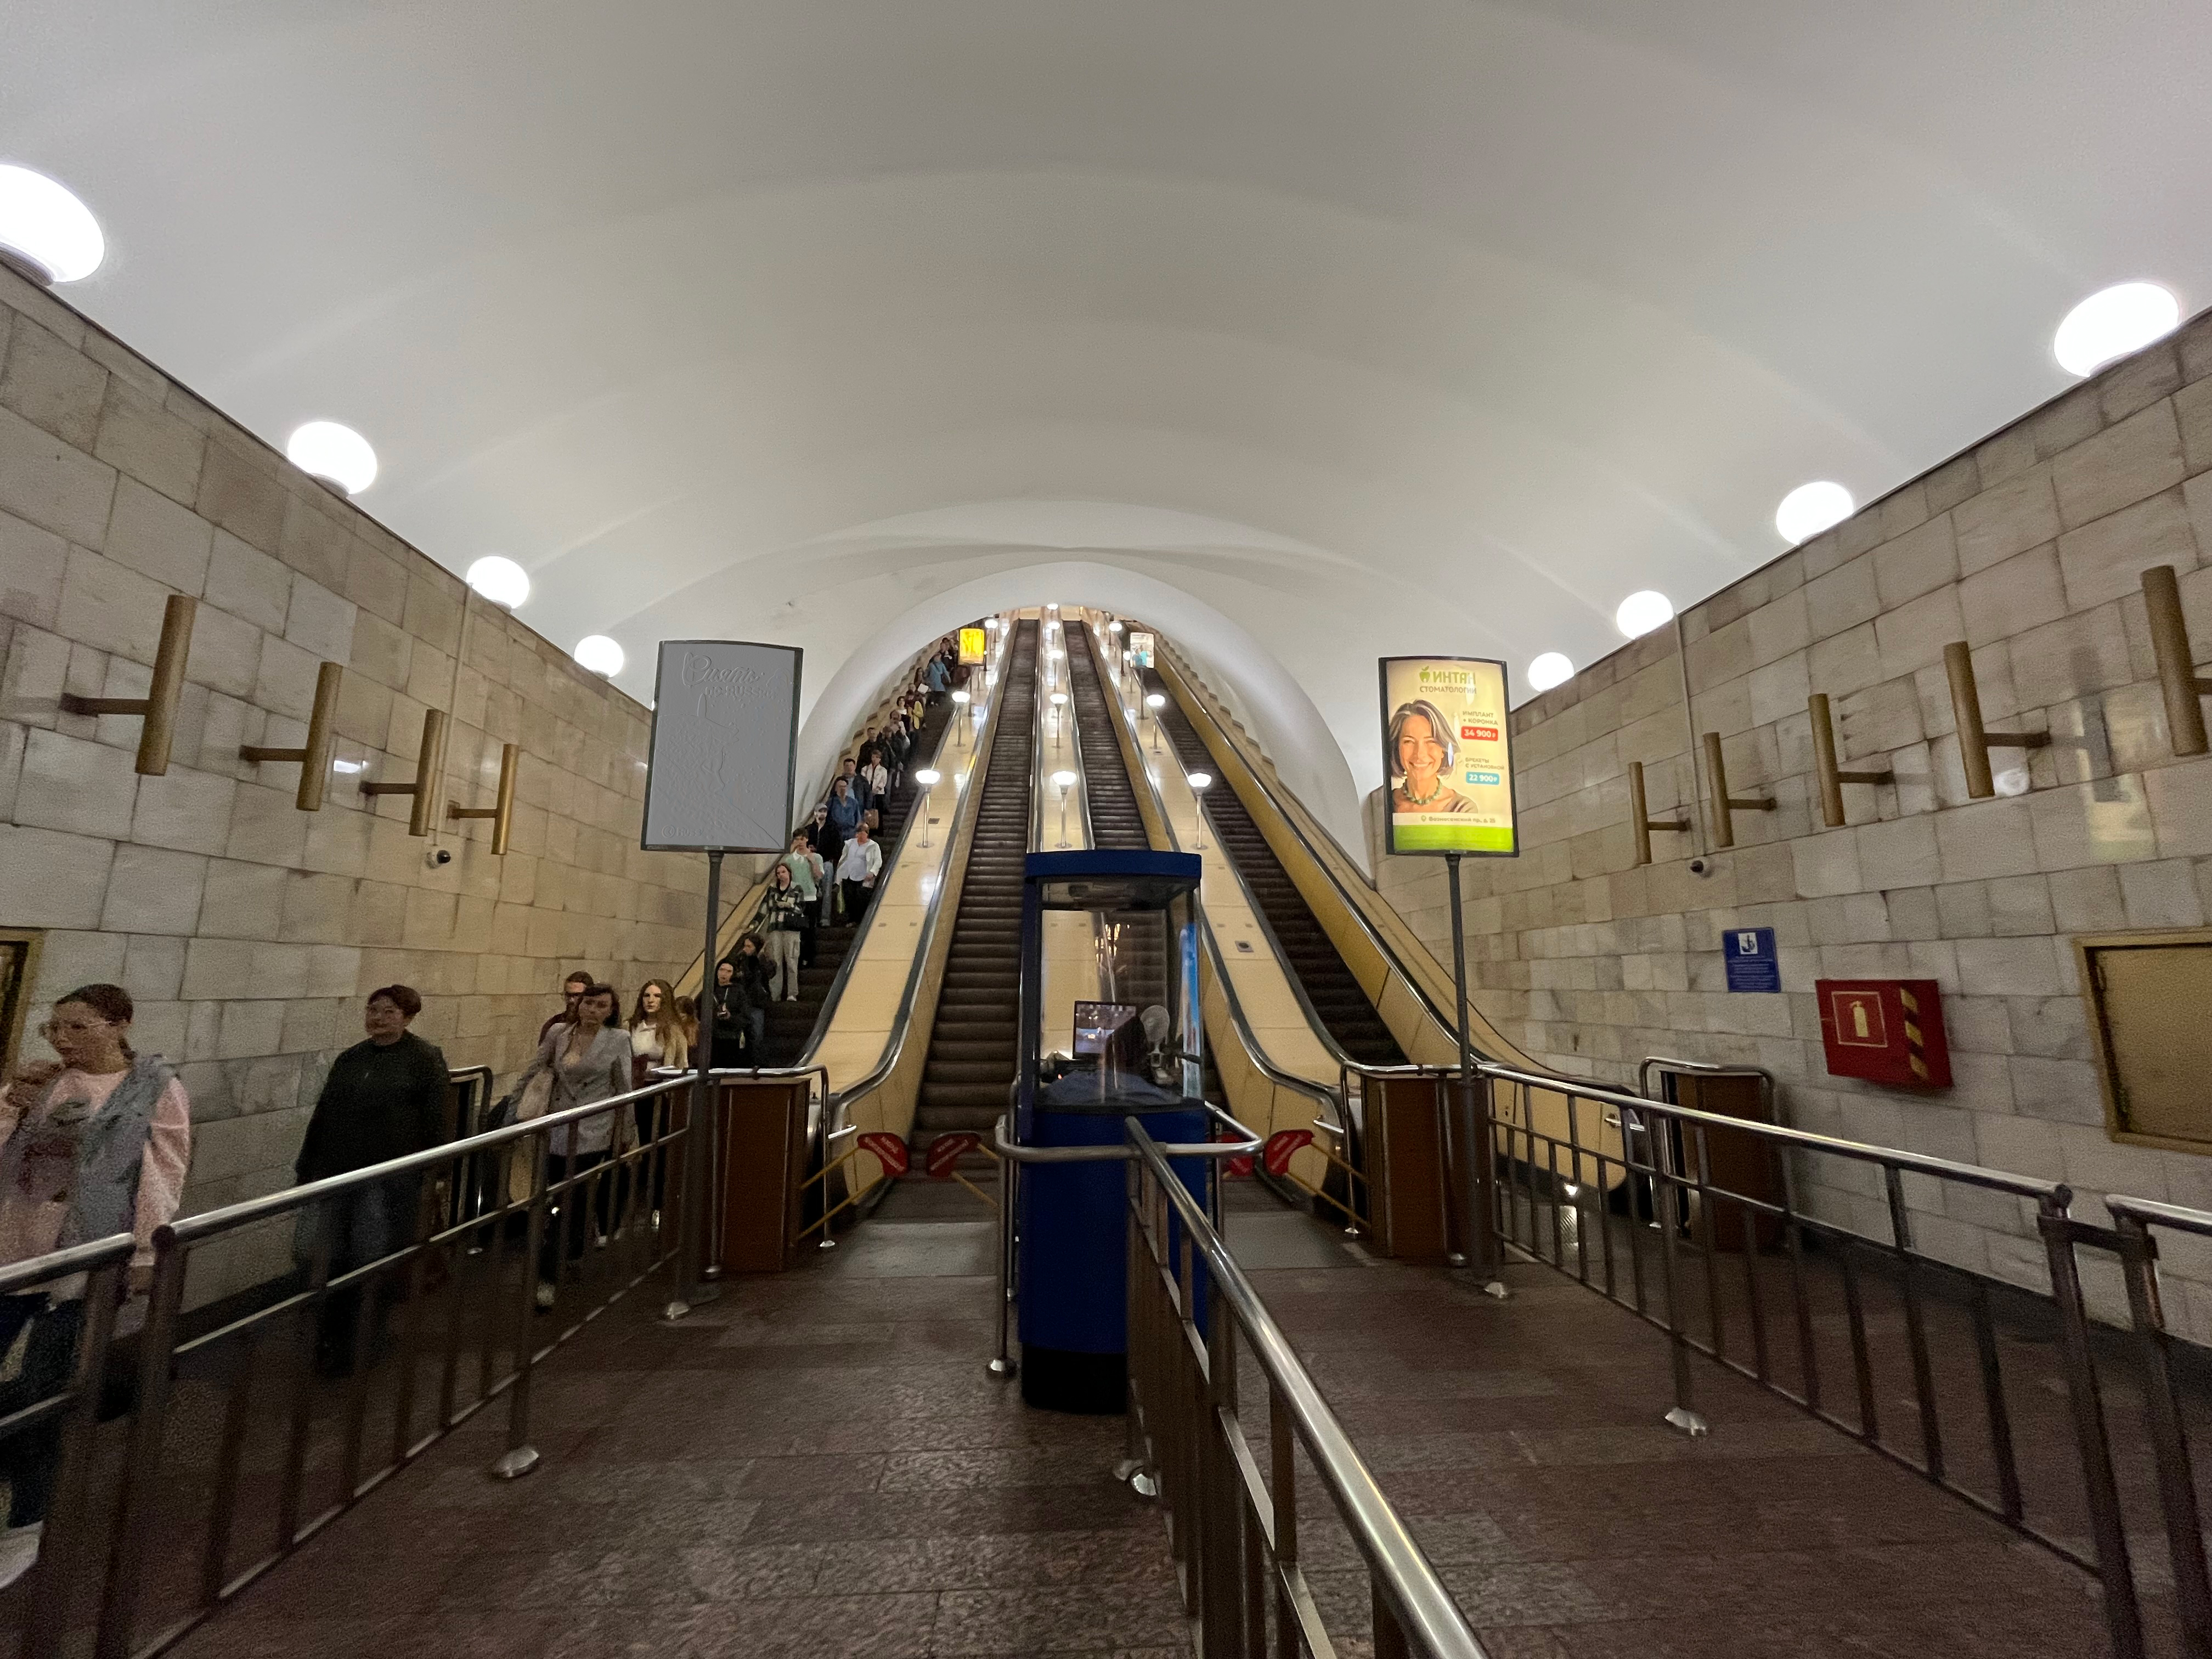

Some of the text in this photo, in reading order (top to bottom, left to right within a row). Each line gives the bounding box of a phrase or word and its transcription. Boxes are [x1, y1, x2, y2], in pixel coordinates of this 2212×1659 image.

[1420, 686, 1477, 694] СТОМАТОЛОГИИ
[1464, 729, 1475, 737] 34
[1469, 774, 1478, 782] 22
